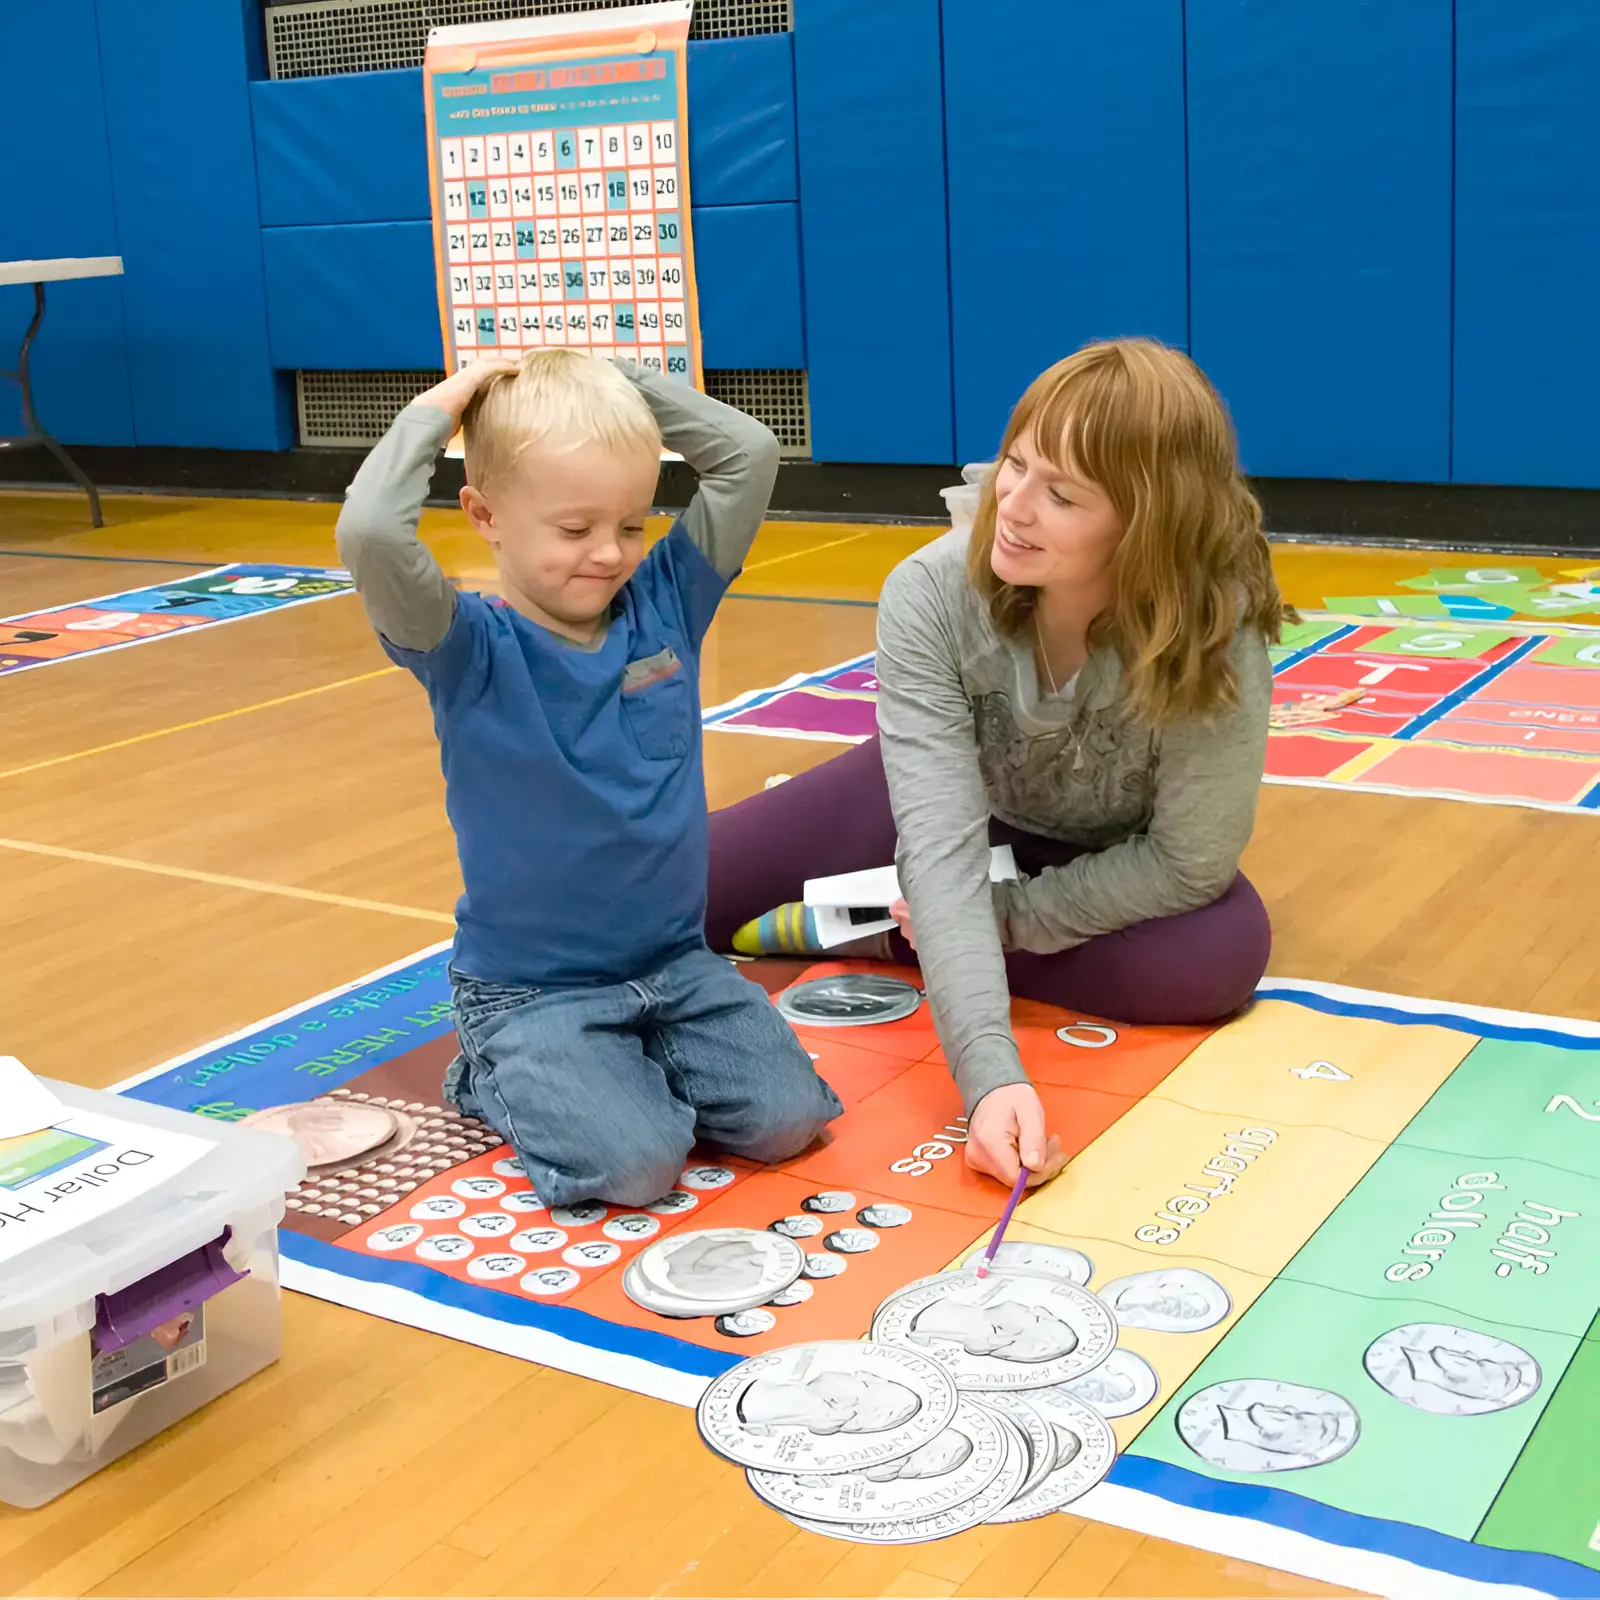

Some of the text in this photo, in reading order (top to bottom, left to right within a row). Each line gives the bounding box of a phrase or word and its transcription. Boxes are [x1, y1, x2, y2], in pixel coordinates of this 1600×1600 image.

[449, 151, 455, 164] 1
[470, 148, 478, 163] 2
[538, 143, 547, 158] 5
[561, 139, 571, 157] 6
[584, 139, 594, 155] 7
[609, 136, 618, 153] 8
[632, 135, 643, 151] 9
[655, 133, 672, 150] 10
[448, 193, 462, 207] 11
[469, 190, 486, 206] 12
[514, 188, 531, 203] 14
[537, 186, 554, 201] 15
[584, 182, 600, 199] 17
[632, 179, 649, 196] 19
[655, 178, 675, 195] 20
[450, 234, 465, 250] 21
[471, 233, 488, 249] 22
[494, 232, 511, 247] 23
[539, 229, 557, 245] 25
[562, 228, 580, 244] 26
[586, 227, 603, 243] 27
[658, 223, 678, 240] 30
[454, 277, 469, 292] 31
[476, 275, 491, 291] 32
[498, 275, 514, 290] 33
[520, 274, 537, 289] 34
[542, 273, 560, 289] 35
[565, 271, 583, 288] 36
[589, 271, 606, 287] 37
[612, 270, 631, 286] 38
[661, 268, 681, 284] 40
[456, 318, 471, 333] 41
[500, 317, 517, 332] 43
[592, 314, 609, 330] 47
[639, 313, 658, 329] 49
[293, 1026, 411, 1077] HERE
[1288, 1060, 1354, 1082] 4
[889, 1116, 969, 1177] mes
[43, 1149, 155, 1203] Dollar
[1134, 1126, 1280, 1245] quarters
